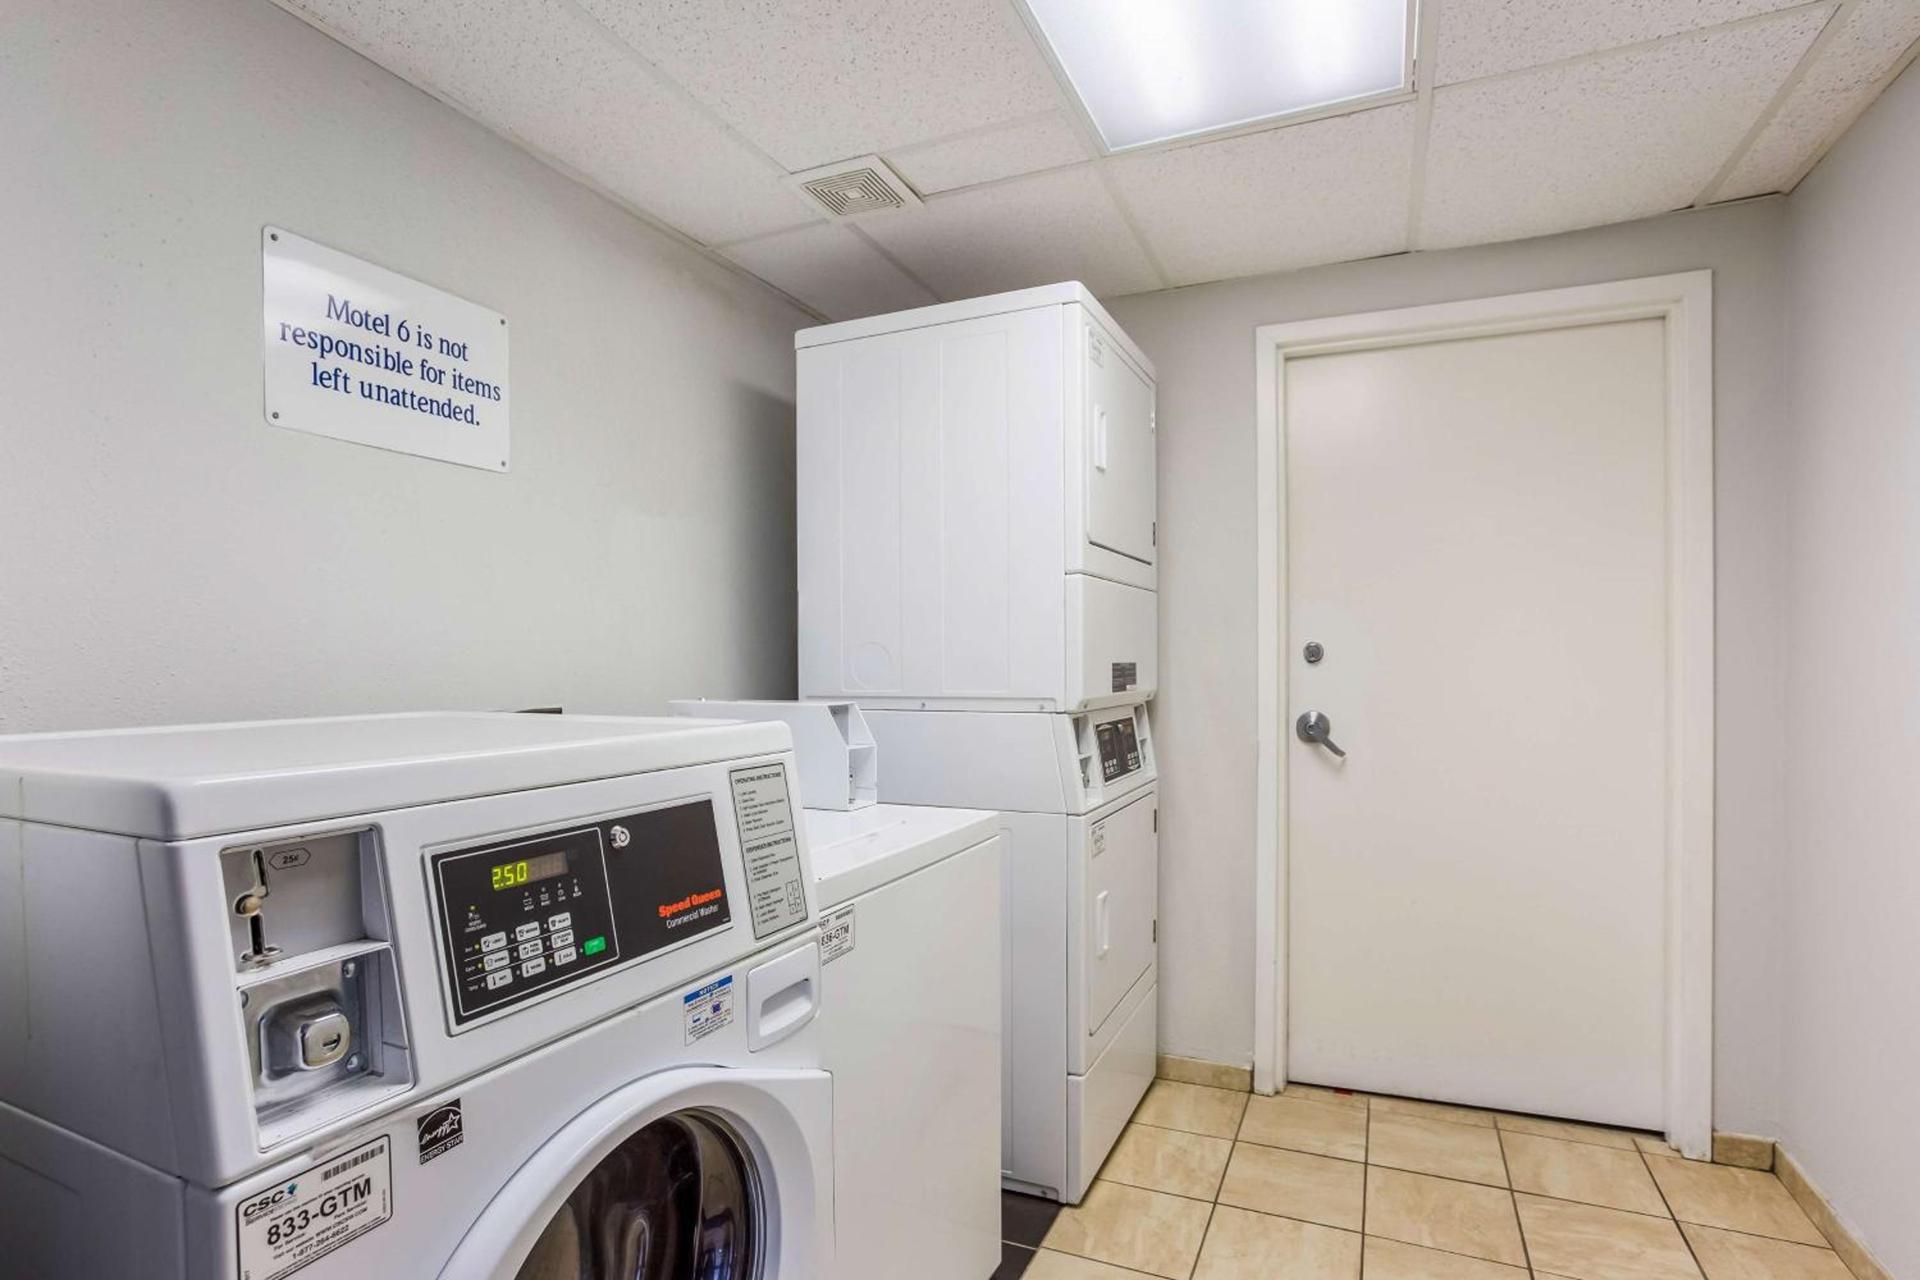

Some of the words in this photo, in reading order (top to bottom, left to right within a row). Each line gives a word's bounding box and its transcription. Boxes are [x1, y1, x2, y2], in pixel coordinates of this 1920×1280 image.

[326, 294, 390, 336] Motel
[397, 320, 410, 342] 6
[417, 325, 432, 349] is
[439, 336, 469, 361] not
[279, 322, 413, 376] responsible
[419, 359, 446, 385] for
[452, 368, 501, 401] items
[311, 362, 352, 394] left
[359, 381, 480, 426] unattended.
[492, 862, 528, 890] 2.50
[658, 896, 691, 918] Speed
[691, 889, 721, 907] Queen
[666, 910, 698, 928] Commercial
[698, 903, 720, 919] Washer
[421, 1145, 446, 1163] ENERGY
[446, 1134, 463, 1149] STAR
[244, 1189, 285, 1217] CSC
[267, 1177, 371, 1245] 833-GTM
